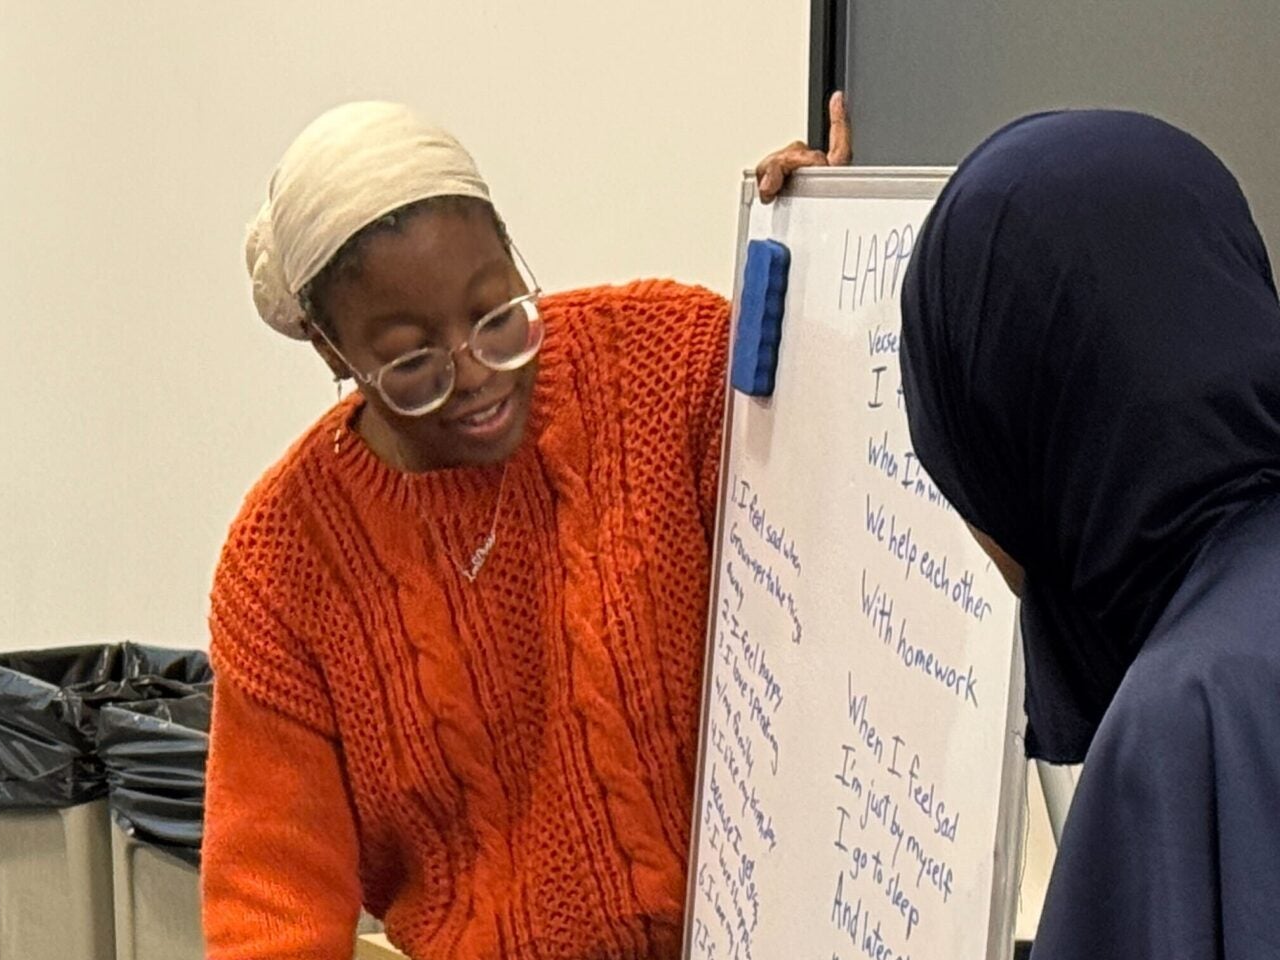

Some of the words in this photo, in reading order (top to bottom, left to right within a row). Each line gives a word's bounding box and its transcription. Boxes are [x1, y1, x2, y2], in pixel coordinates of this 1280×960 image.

[838, 223, 915, 312] HAPP
[868, 366, 888, 408] I
[868, 431, 898, 479] When
[866, 493, 885, 541] We
[889, 515, 918, 581] help
[919, 556, 950, 597] each
[952, 570, 992, 622] other
[861, 568, 894, 644] With
[897, 618, 978, 708] homework
[847, 671, 883, 763] When
[887, 735, 906, 778] I
[908, 754, 934, 818] feel
[834, 806, 851, 852] I
[849, 847, 868, 880] go
[871, 851, 883, 885] to
[885, 872, 920, 941] sleep
[835, 744, 863, 799] I'm
[859, 779, 891, 830] just
[889, 804, 904, 869] by
[906, 835, 953, 904] myself
[831, 870, 862, 945] And
